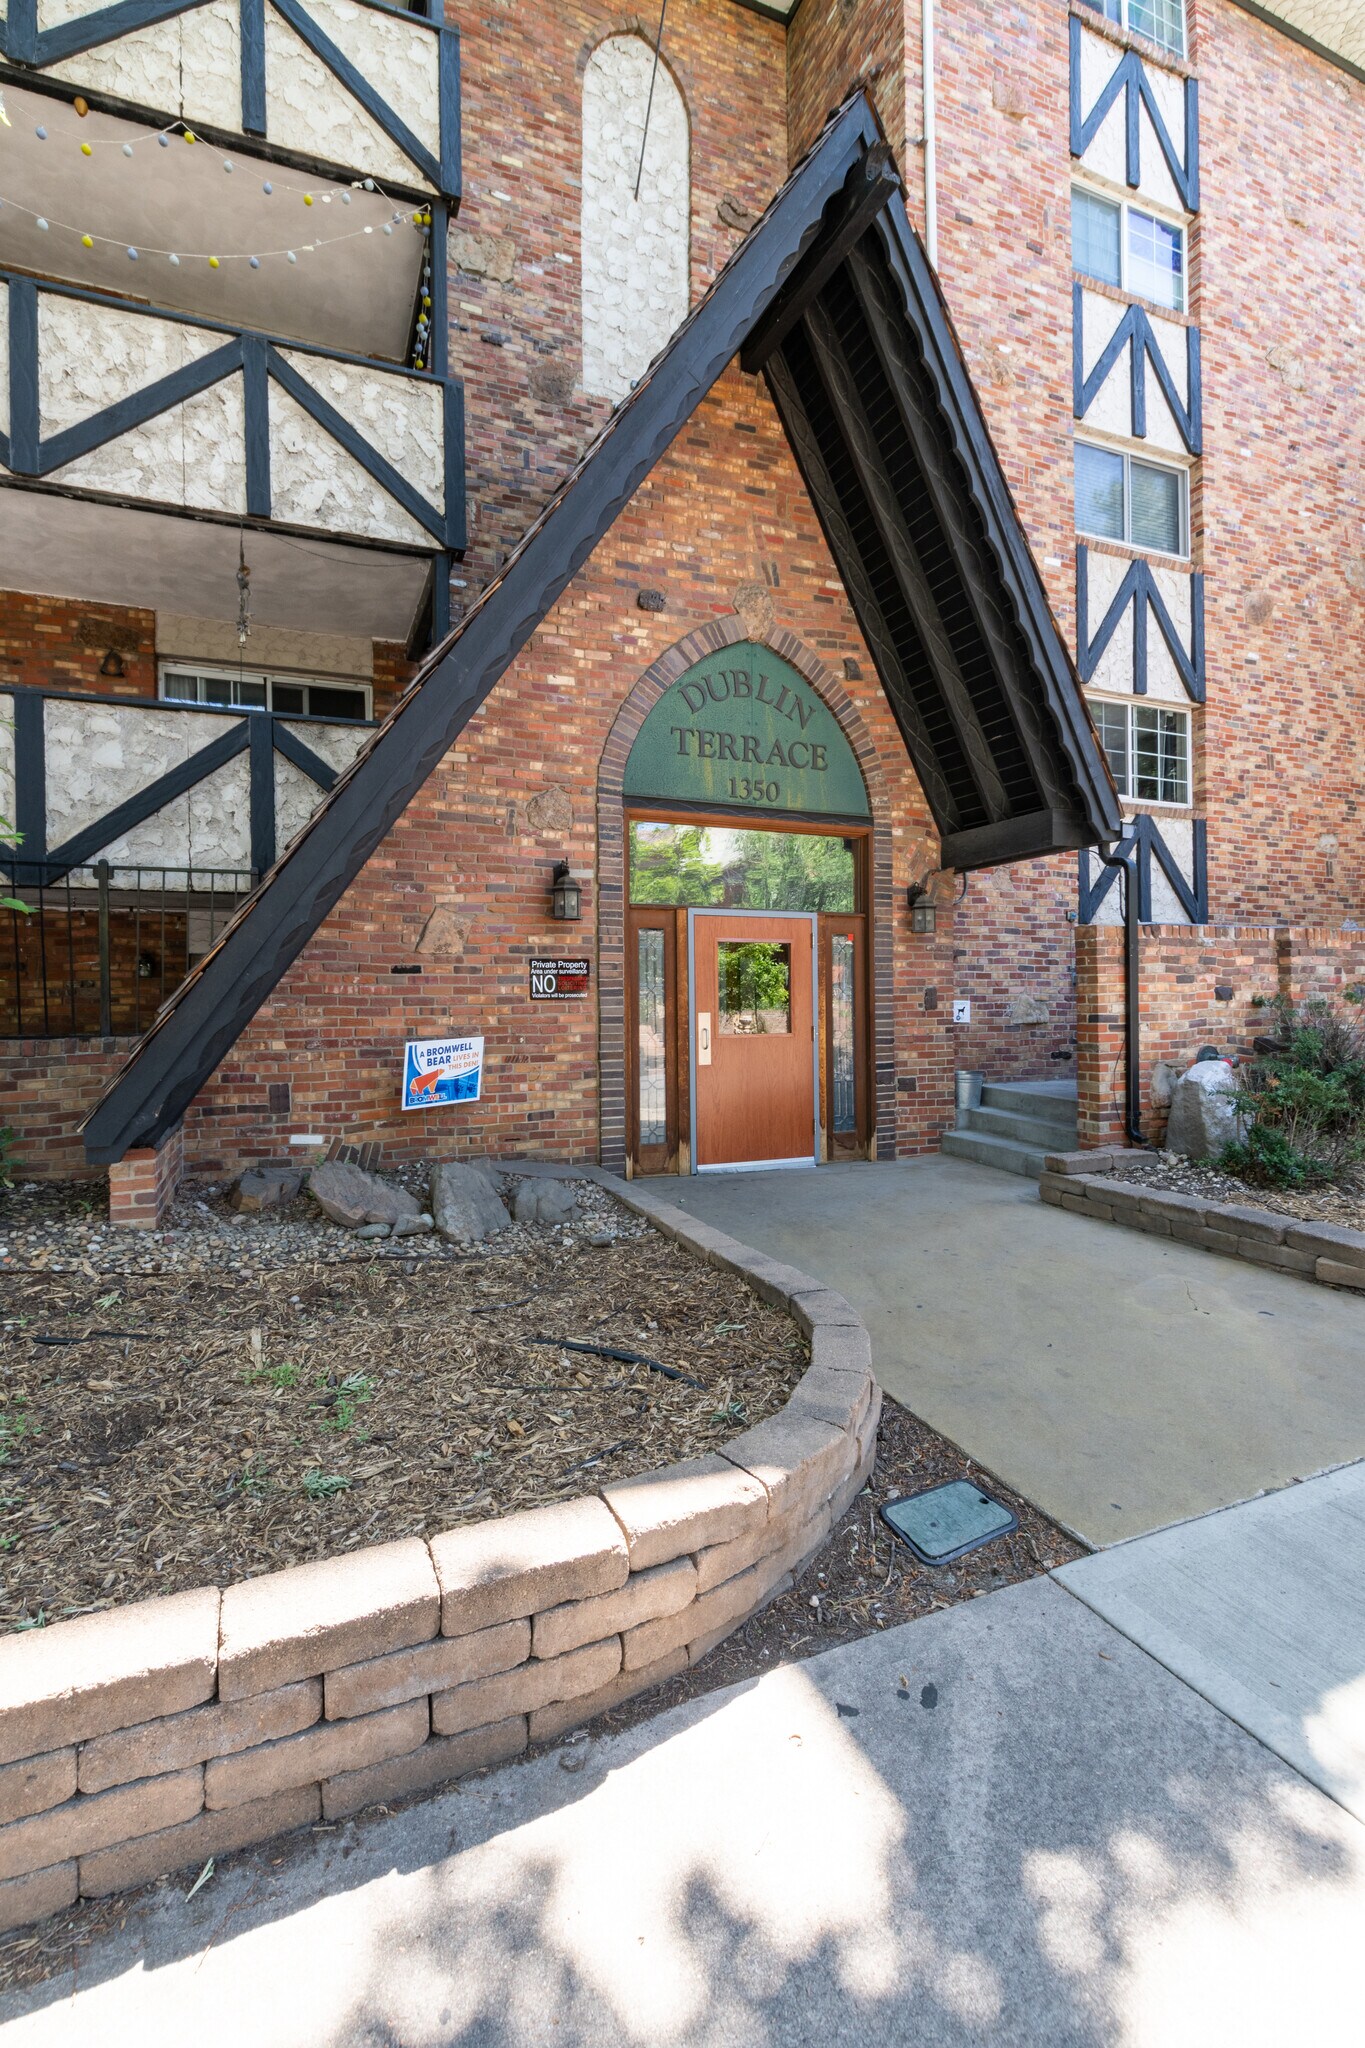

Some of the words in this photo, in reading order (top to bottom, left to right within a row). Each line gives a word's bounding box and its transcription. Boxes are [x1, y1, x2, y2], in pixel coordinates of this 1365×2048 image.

[678, 669, 816, 730] DUBLIN
[670, 726, 829, 771] TERRACE
[729, 777, 781, 802] 1350
[558, 961, 587, 969] Property
[532, 975, 556, 992] NO
[427, 1043, 472, 1056] BROMWELL
[427, 1056, 451, 1066] BEAR
[453, 1053, 470, 1061] LIVES
[463, 1060, 479, 1068] DEN!
